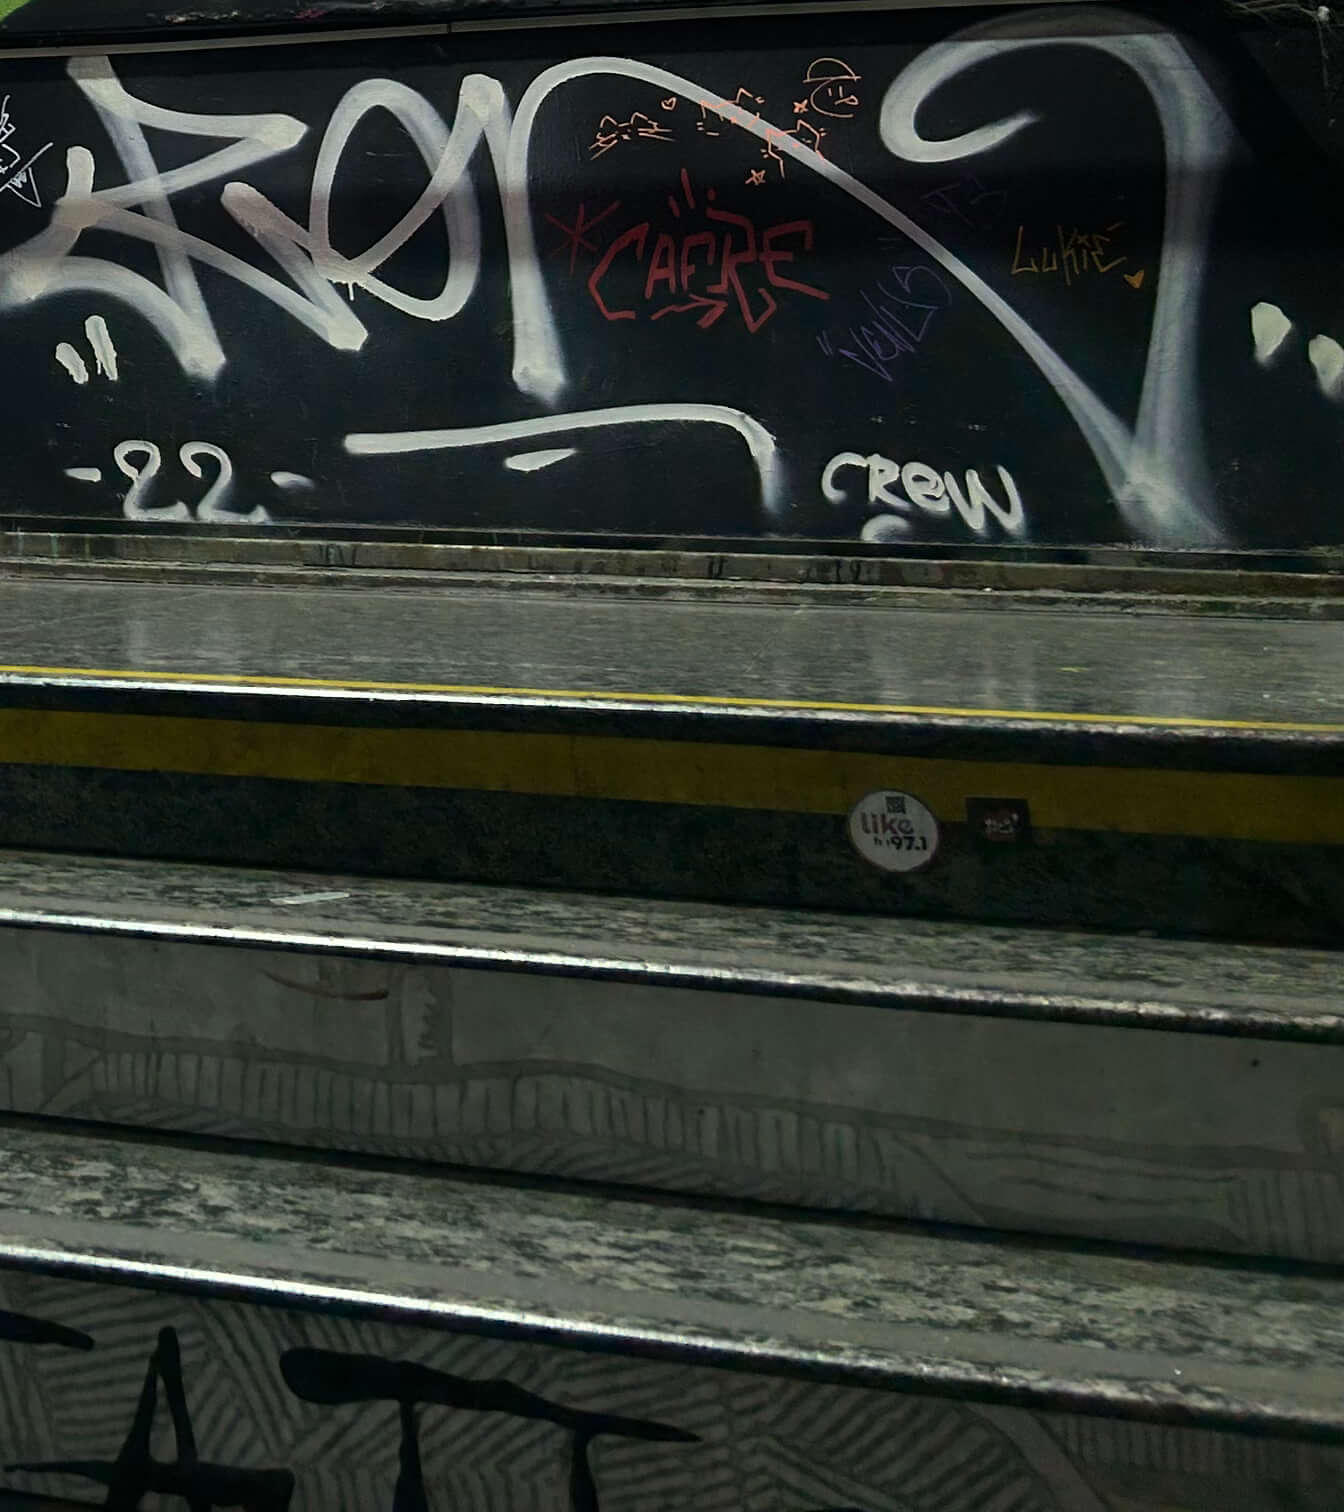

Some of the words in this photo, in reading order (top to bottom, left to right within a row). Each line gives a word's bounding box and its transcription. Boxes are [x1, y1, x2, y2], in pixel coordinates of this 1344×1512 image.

[588, 208, 831, 334] CAFRE
[862, 812, 914, 835] like
[890, 836, 928, 852] 97.1
